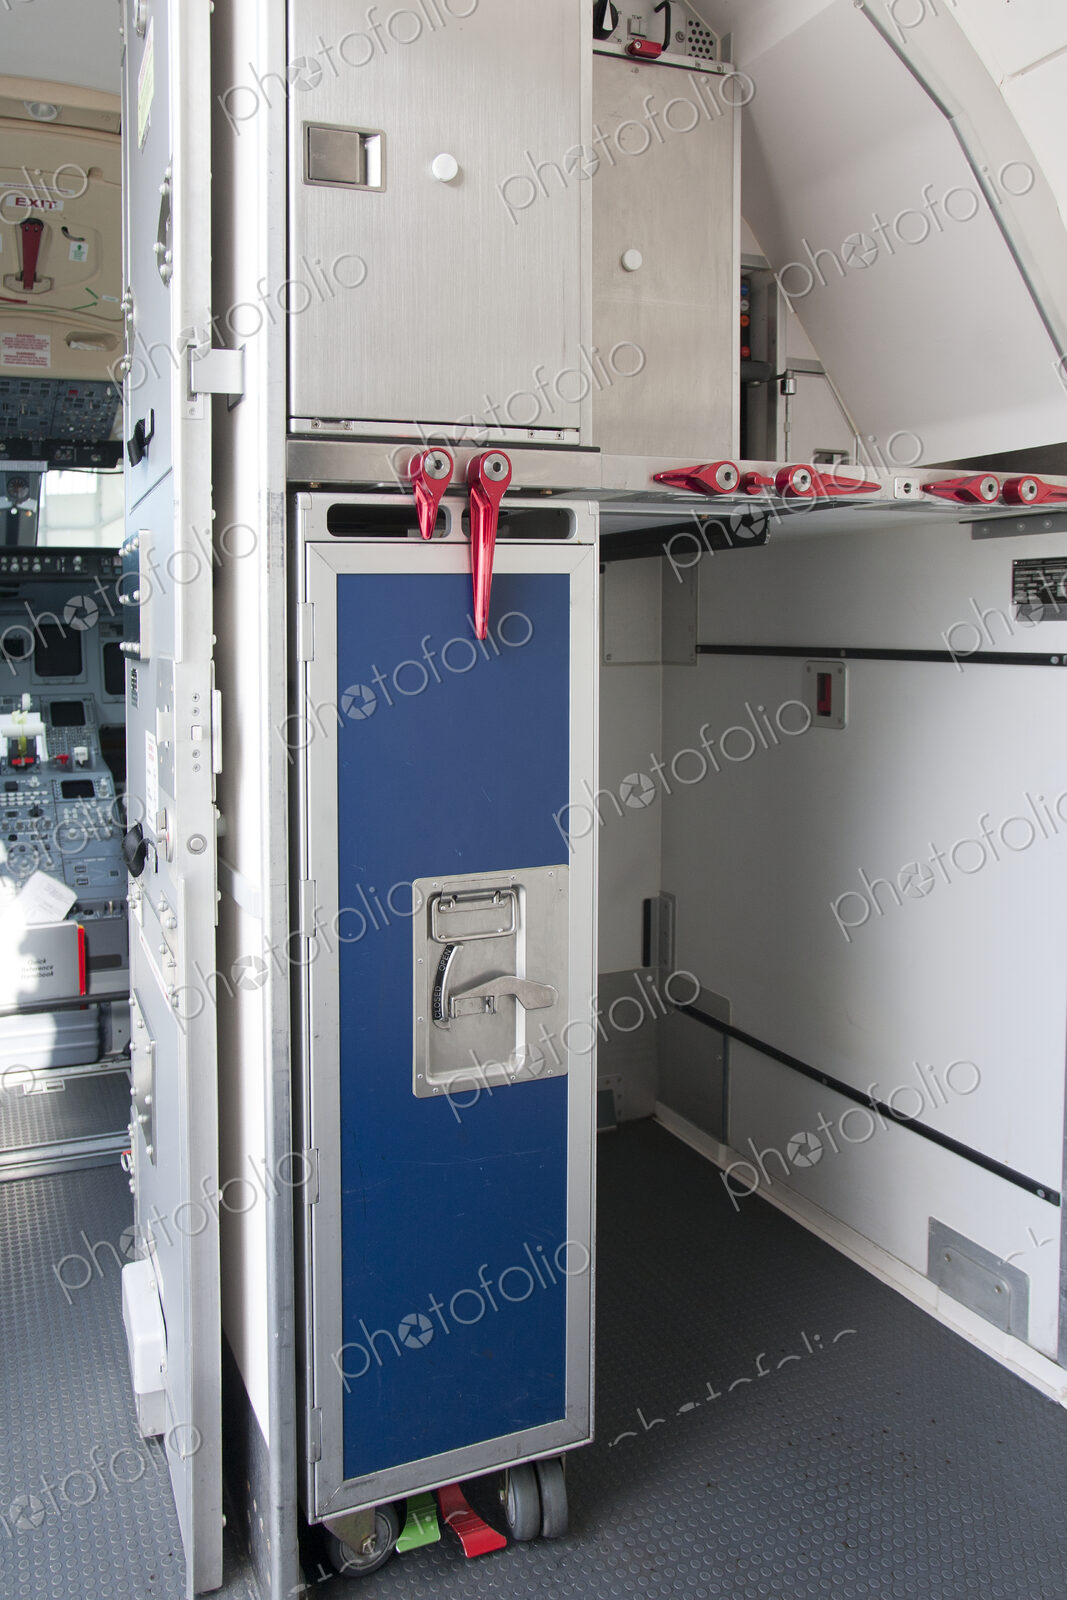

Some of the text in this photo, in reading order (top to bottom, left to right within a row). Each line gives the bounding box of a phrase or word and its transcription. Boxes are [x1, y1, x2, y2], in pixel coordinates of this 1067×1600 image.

[15, 197, 57, 209] EXIT
[438, 948, 452, 972] OPEN
[434, 985, 442, 1018] CLOSED
